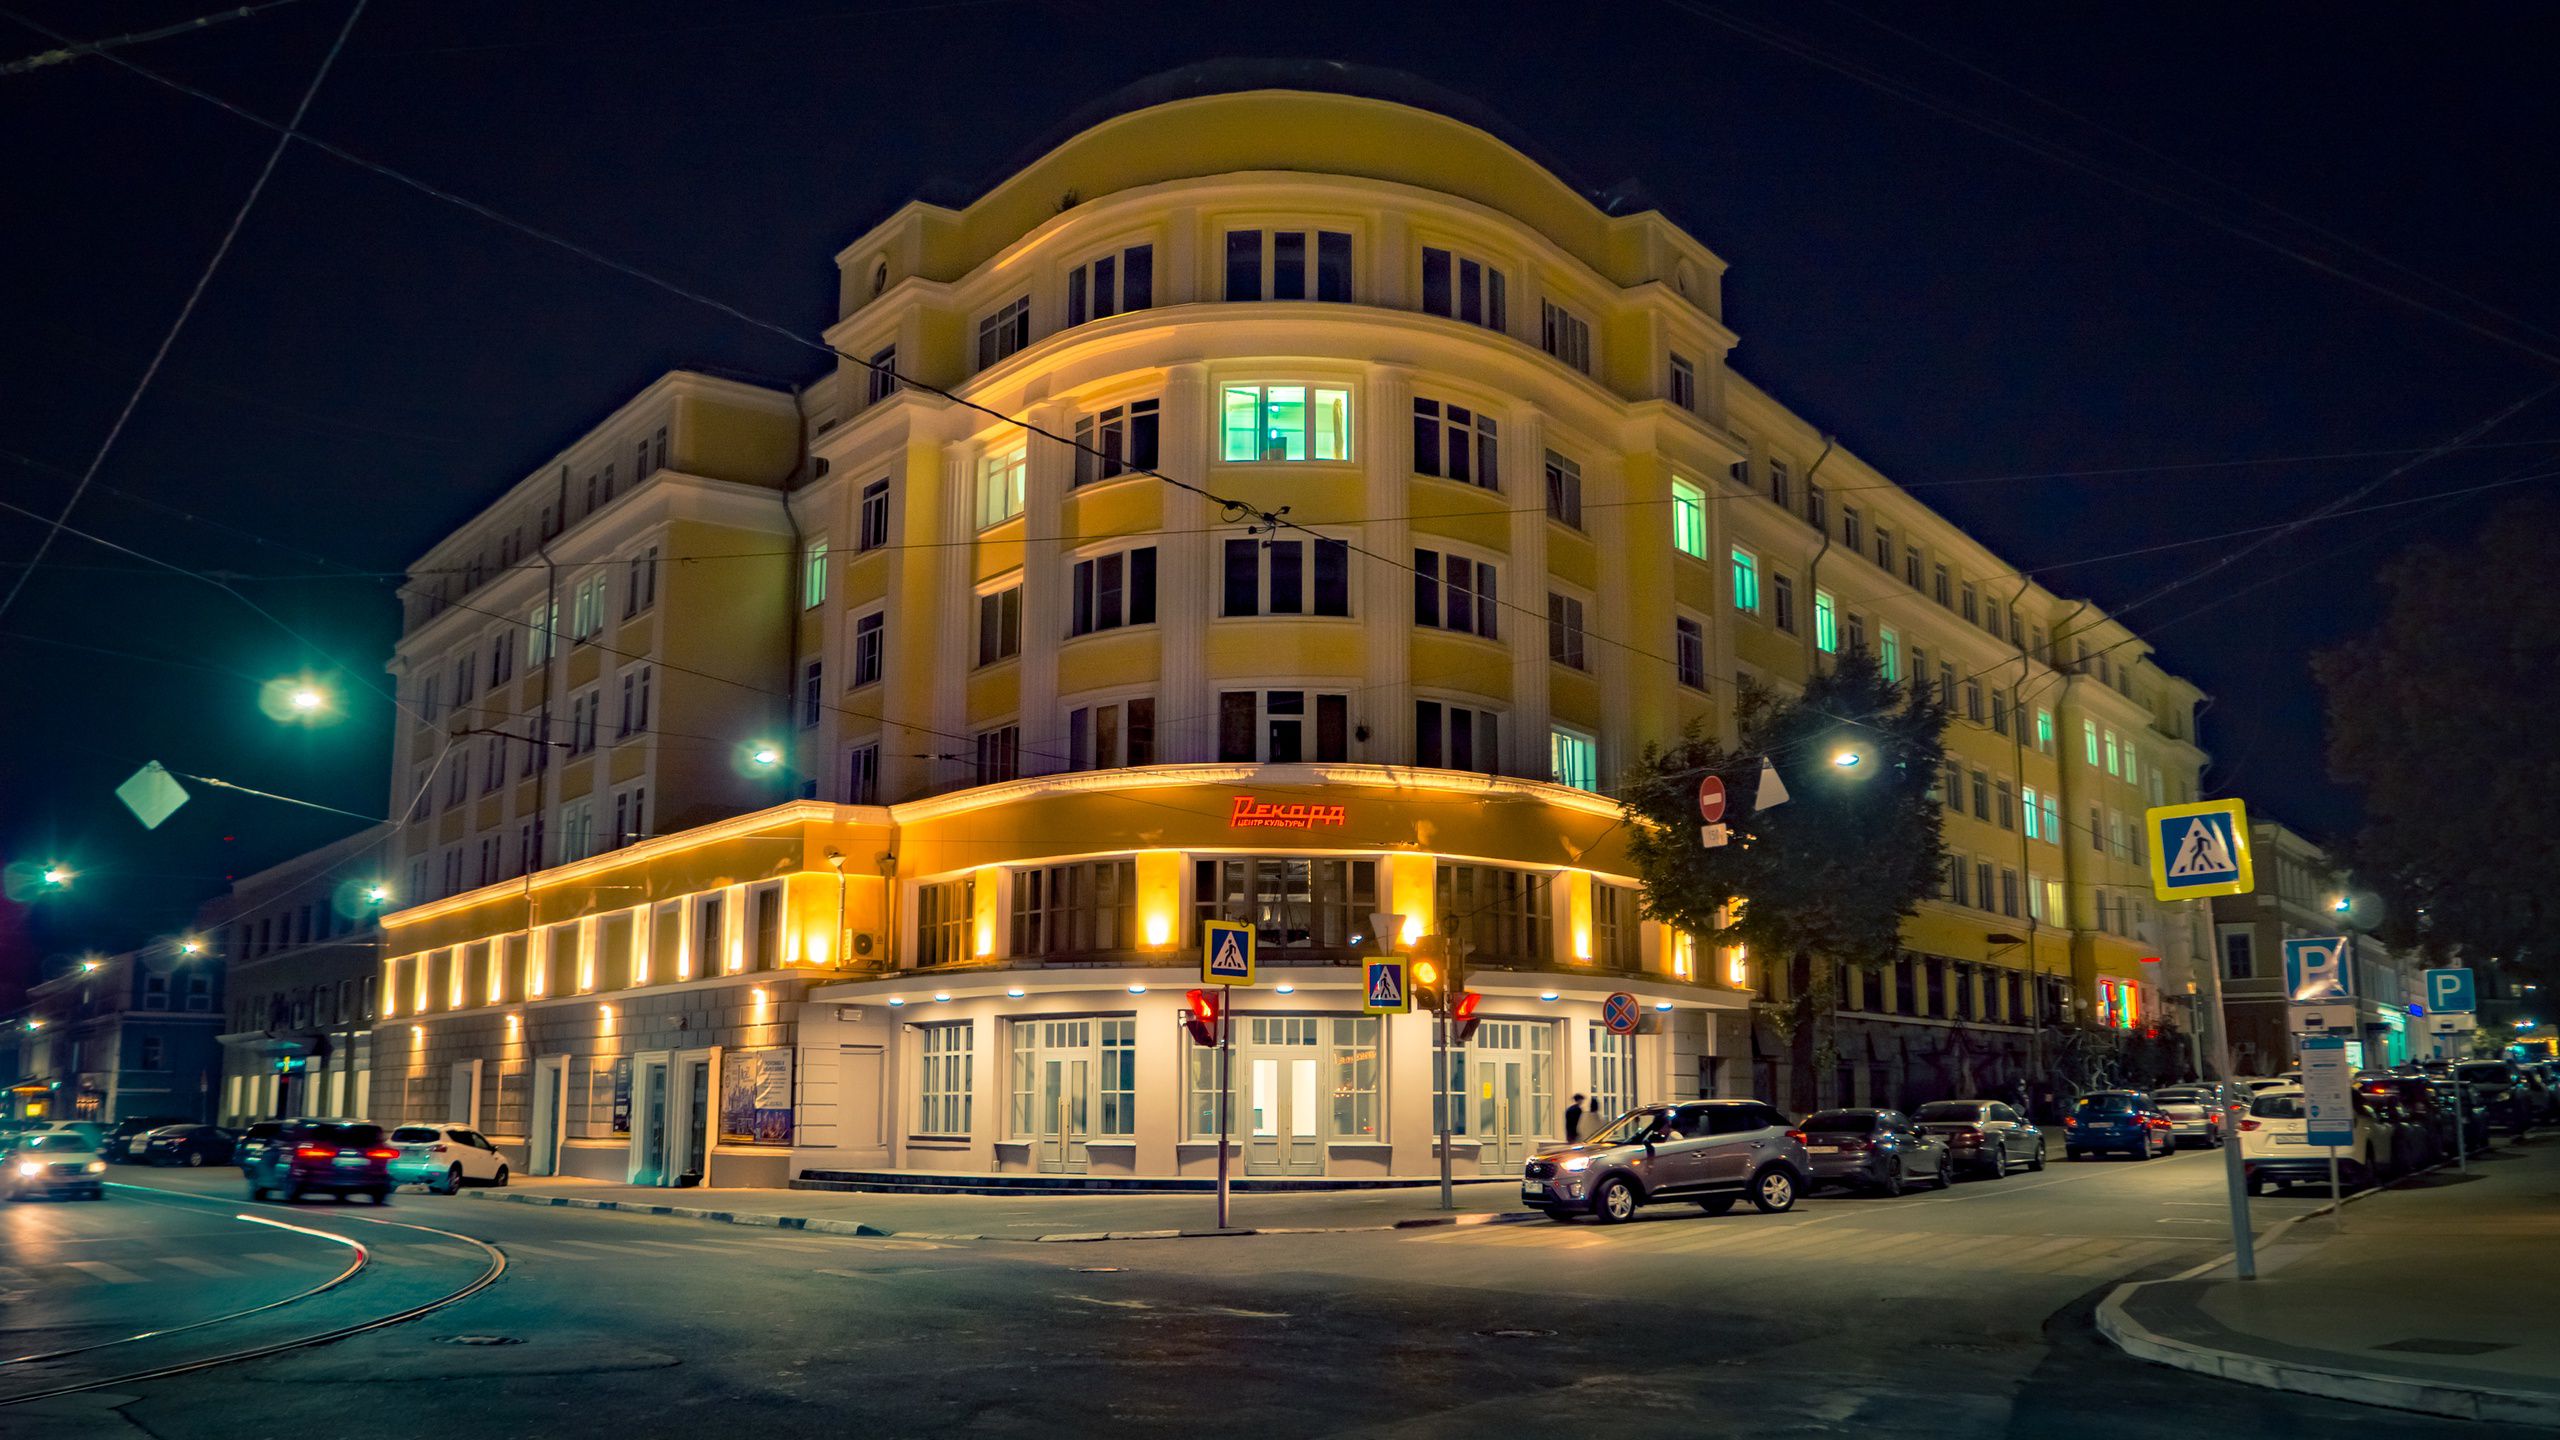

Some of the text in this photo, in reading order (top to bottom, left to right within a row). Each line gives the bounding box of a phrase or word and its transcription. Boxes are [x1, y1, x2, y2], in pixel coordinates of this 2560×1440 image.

[1237, 819, 1306, 828] ЦЕНТР КУЛЬТУРЫ
[2298, 946, 2334, 994] P
[2436, 975, 2461, 1007] P
